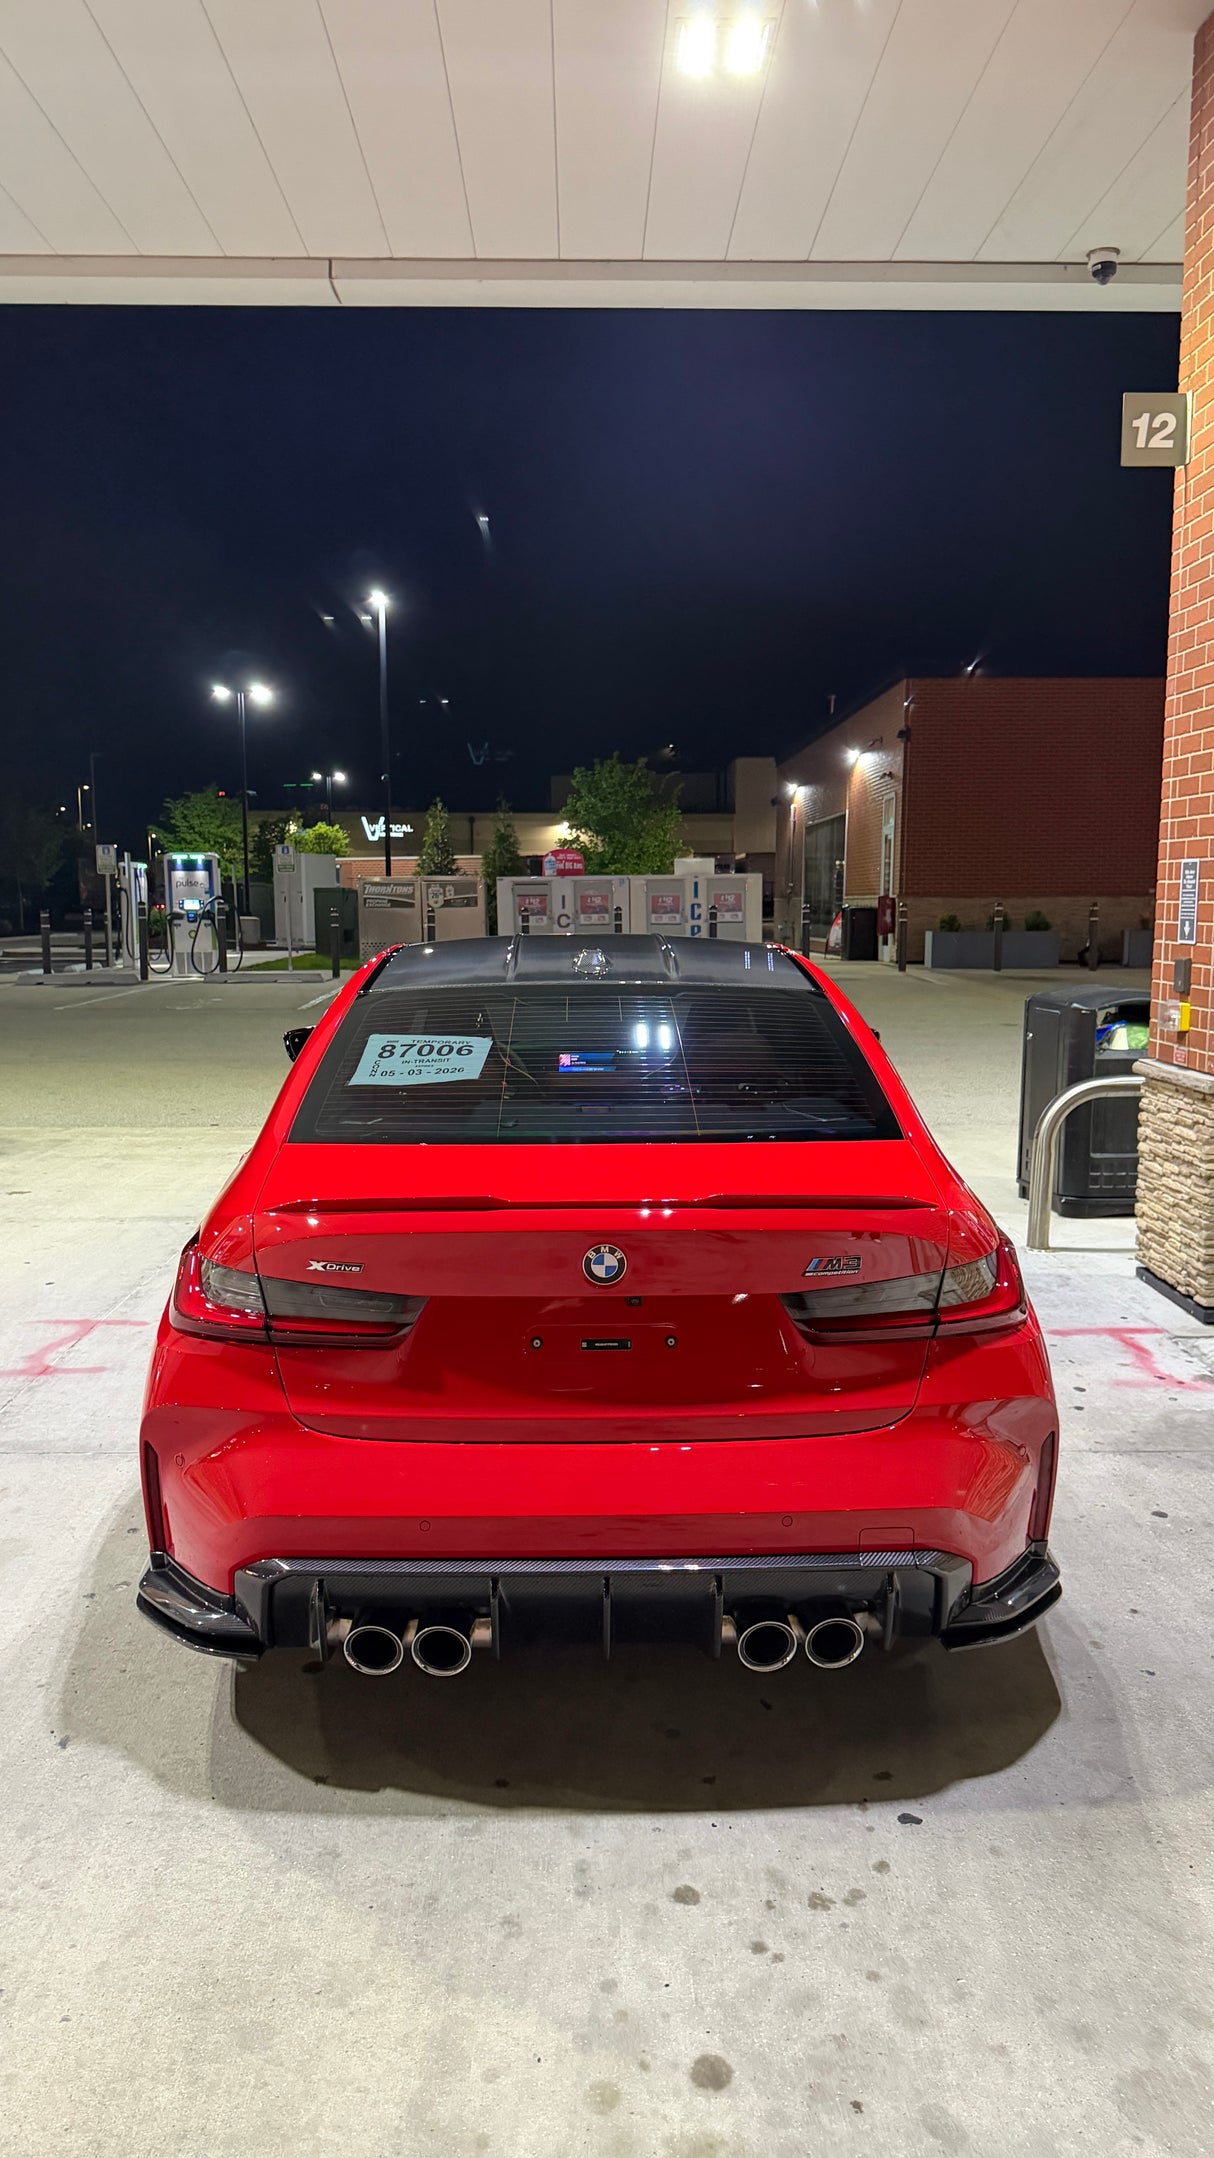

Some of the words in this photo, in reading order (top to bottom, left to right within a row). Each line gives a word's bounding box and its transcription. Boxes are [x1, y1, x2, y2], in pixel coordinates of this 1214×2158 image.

[1132, 412, 1177, 449] 12
[176, 878, 199, 889] pulse
[557, 895, 571, 928] IC
[378, 1044, 474, 1059] 87006
[587, 1246, 623, 1259] BMW
